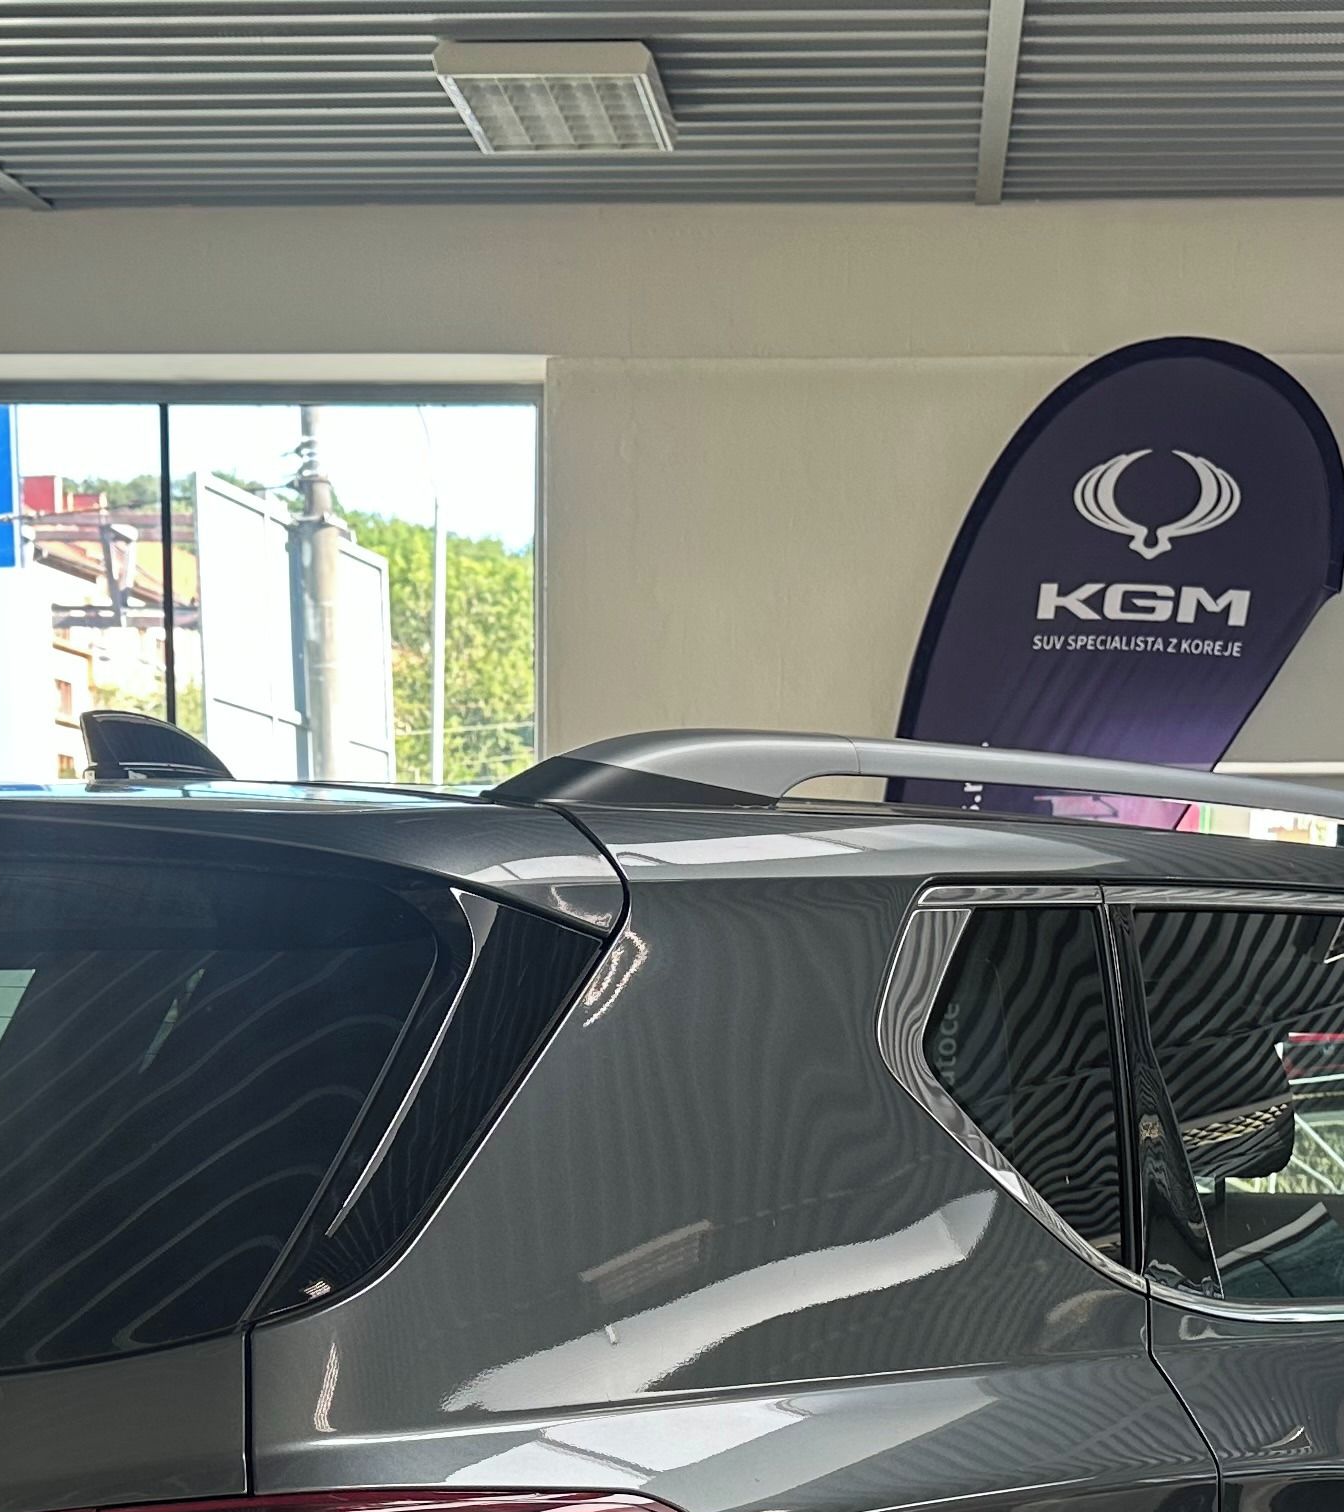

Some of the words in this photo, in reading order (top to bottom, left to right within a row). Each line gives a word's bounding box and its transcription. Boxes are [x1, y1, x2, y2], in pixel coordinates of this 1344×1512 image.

[1036, 582, 1252, 627] KGM
[1032, 635, 1065, 651] SUV
[1066, 635, 1164, 653] SPECIALISTA
[1166, 638, 1178, 653] Z
[1180, 639, 1243, 657] KOREJE
